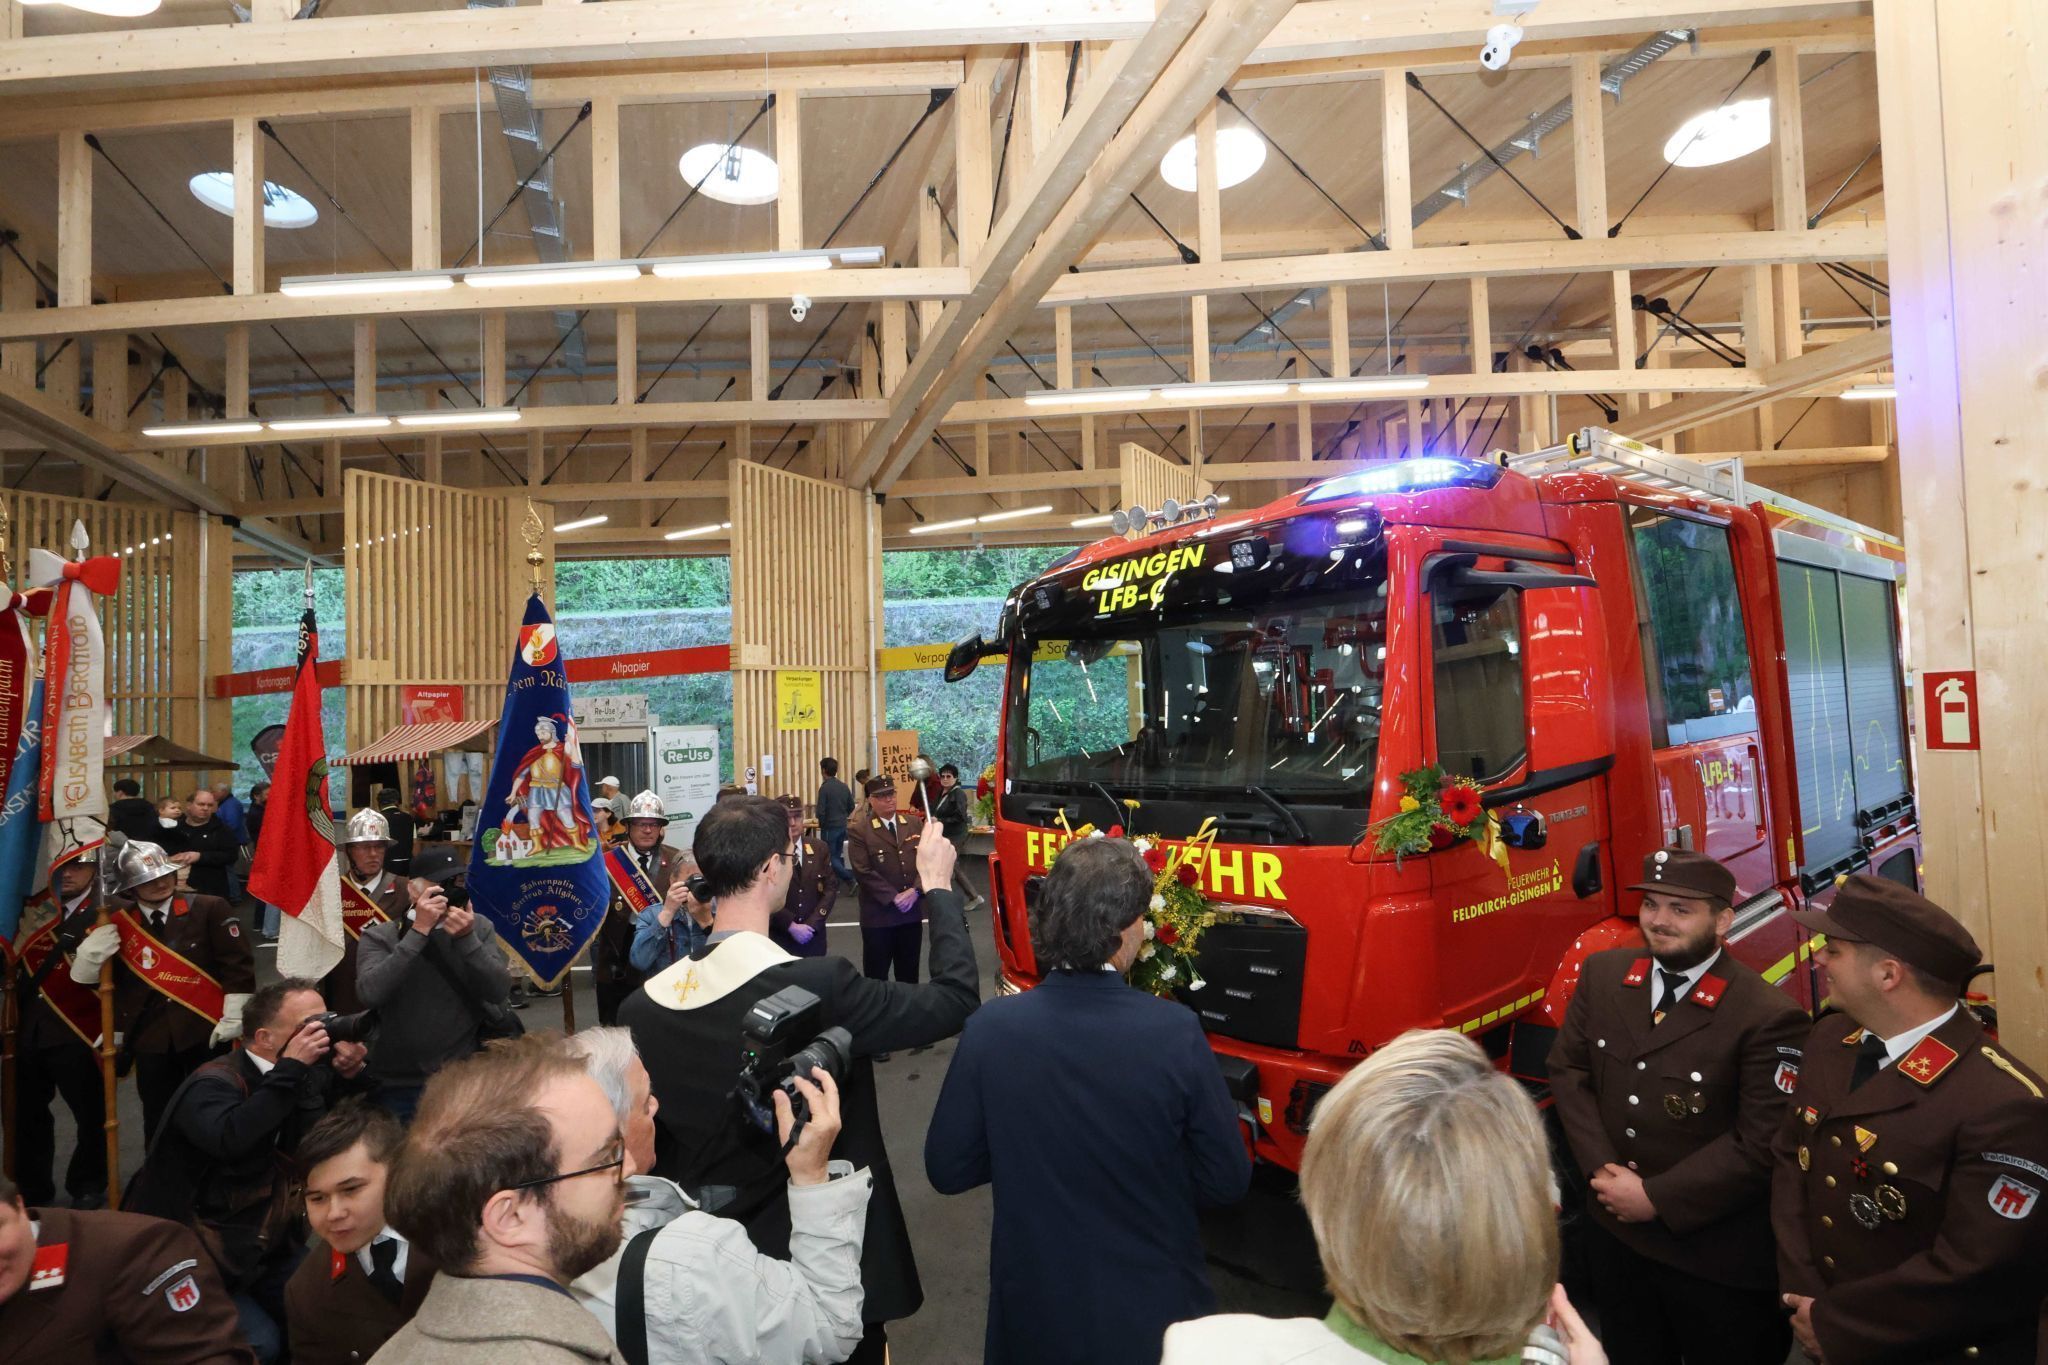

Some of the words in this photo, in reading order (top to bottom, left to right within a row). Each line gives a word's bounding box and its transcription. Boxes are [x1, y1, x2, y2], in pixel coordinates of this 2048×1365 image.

[1082, 544, 1205, 591] GISINGEN
[1099, 578, 1165, 614] LFB-C
[297, 621, 309, 655] 1957
[914, 651, 950, 667] Verpac
[1047, 642, 1068, 655] Sac
[611, 659, 650, 677] Altpapier
[667, 749, 710, 763] Re-Use
[883, 753, 913, 765] FACH
[1703, 758, 1735, 787] LFB-C
[1508, 867, 1550, 891] FEUERWEHR
[627, 886, 645, 911] Gisin
[1453, 882, 1551, 922] FELDKIRCH-GISINGEN
